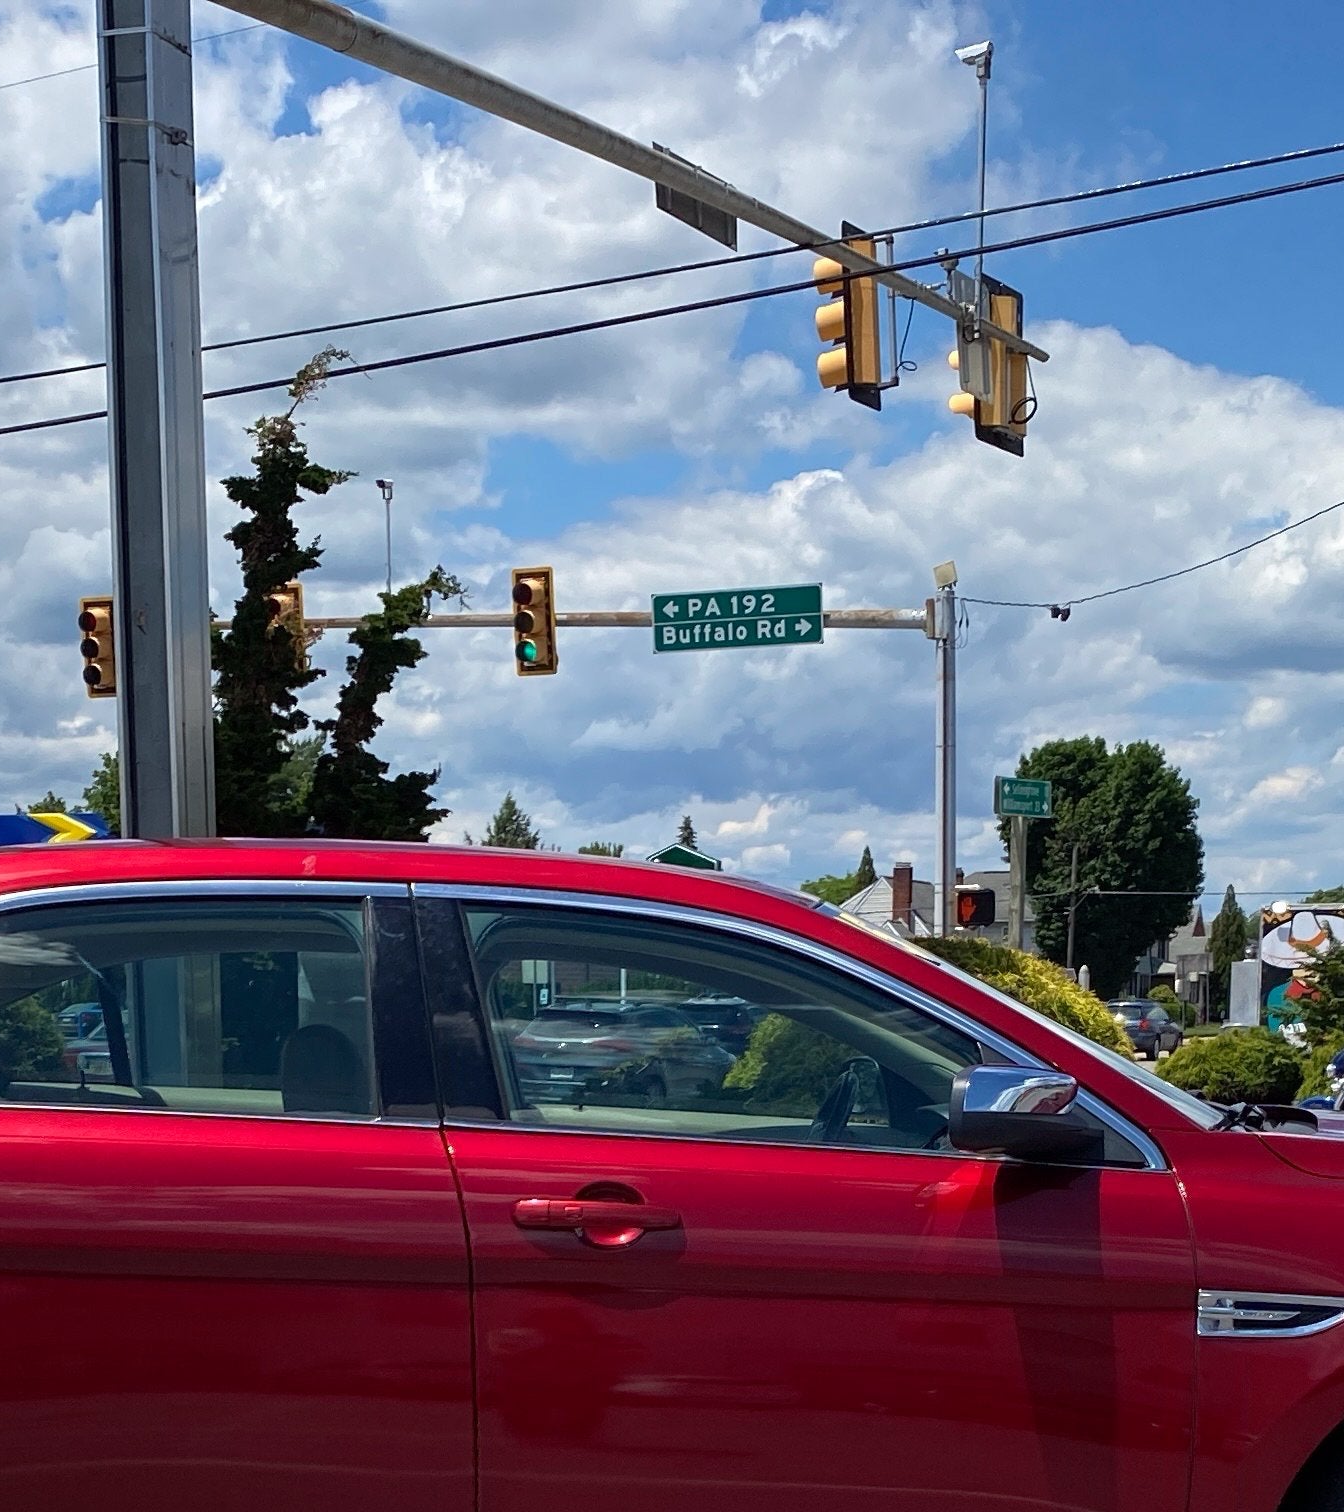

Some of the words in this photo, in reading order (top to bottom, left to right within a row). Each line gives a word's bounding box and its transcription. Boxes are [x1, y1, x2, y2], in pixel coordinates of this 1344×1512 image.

[687, 598, 721, 618] PA
[731, 593, 775, 614] 192
[662, 622, 747, 645] Buffalo
[757, 618, 785, 639] Rd
